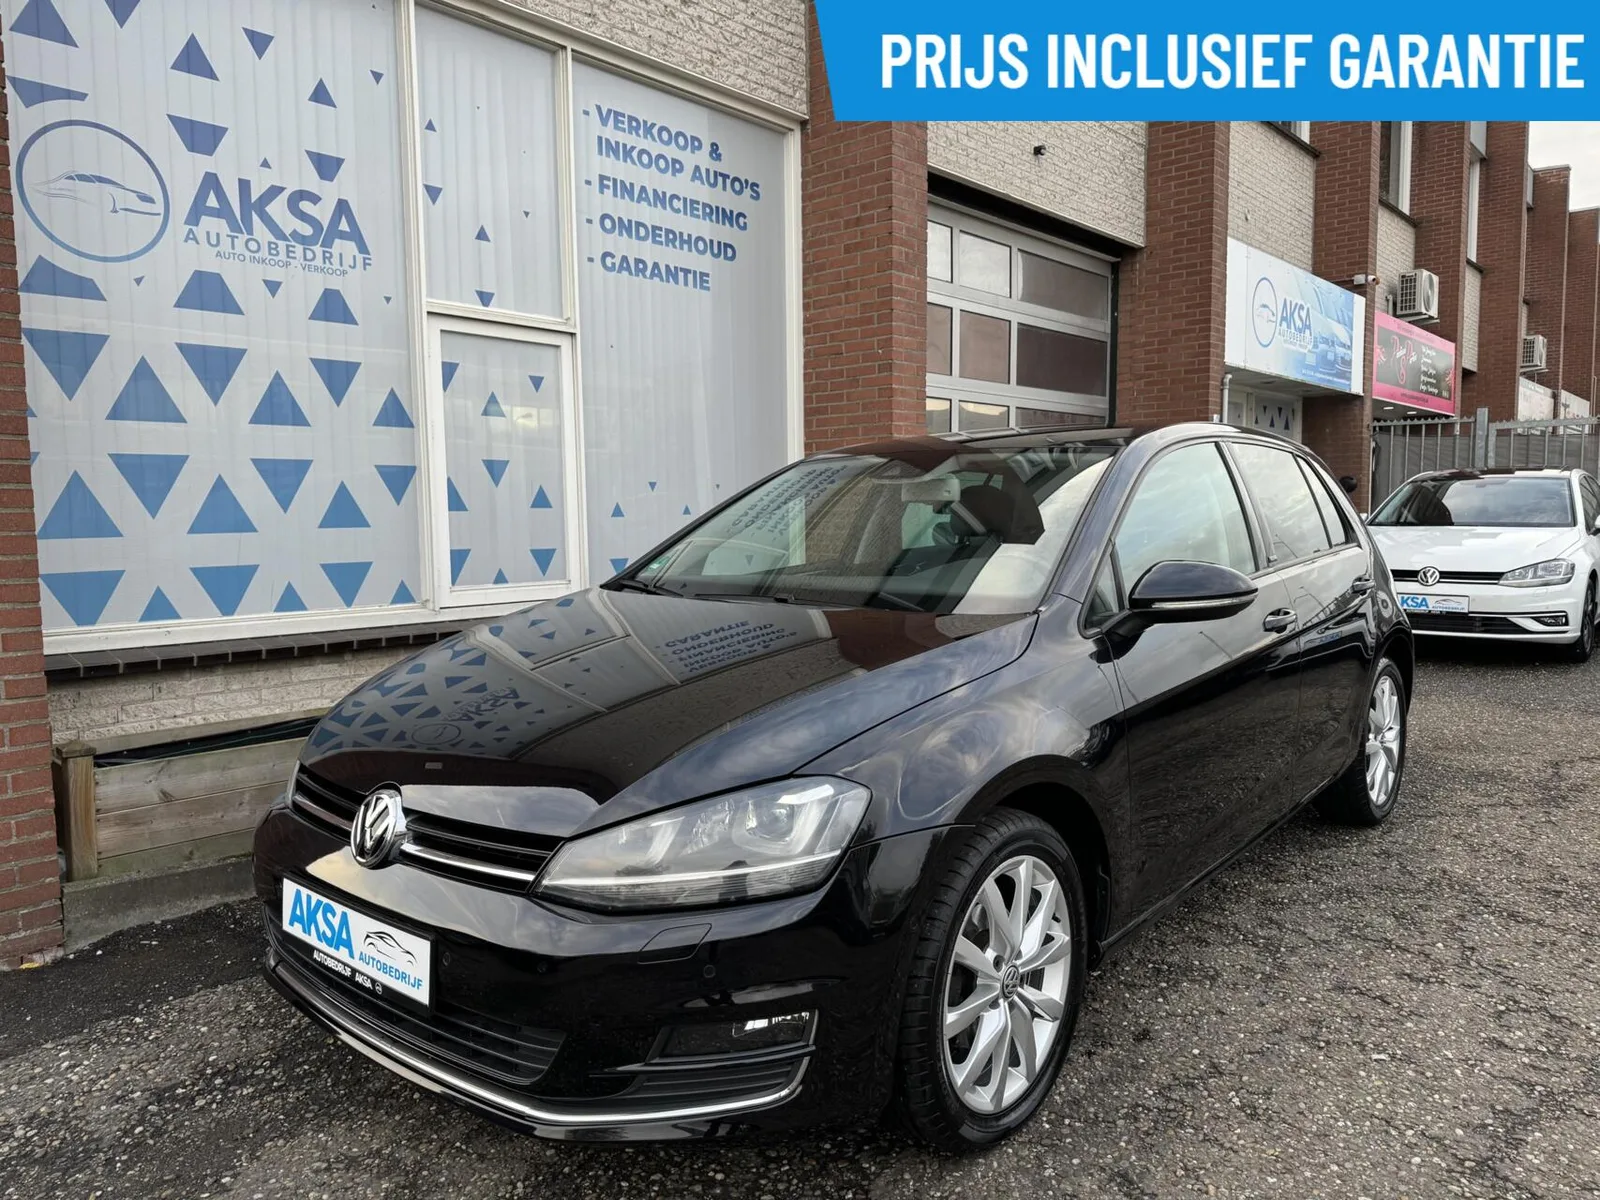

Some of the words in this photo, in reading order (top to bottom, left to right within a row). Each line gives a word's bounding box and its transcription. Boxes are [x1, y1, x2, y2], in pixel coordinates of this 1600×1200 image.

[595, 104, 703, 154] VERKOOP
[708, 141, 723, 163] &
[596, 135, 685, 177] INKOOP
[690, 164, 761, 201] AUTO'S
[183, 170, 371, 256] AKSA
[598, 173, 748, 231] FINANCIERING
[183, 227, 373, 271] AUTOBEDRIJF
[599, 213, 737, 262] ONDERHOUD
[215, 250, 246, 263] AUTO
[249, 254, 292, 269] INKOOP
[300, 262, 349, 278] VERKOOP
[600, 251, 711, 291] GARANTIE
[1279, 297, 1312, 337] AKSA
[1400, 596, 1429, 608] KSA
[288, 887, 355, 960] AKSA
[312, 949, 352, 978] AUTOBEDRIJF
[354, 972, 374, 991] AKSA
[359, 950, 424, 990] AUTOBEDRIJF
